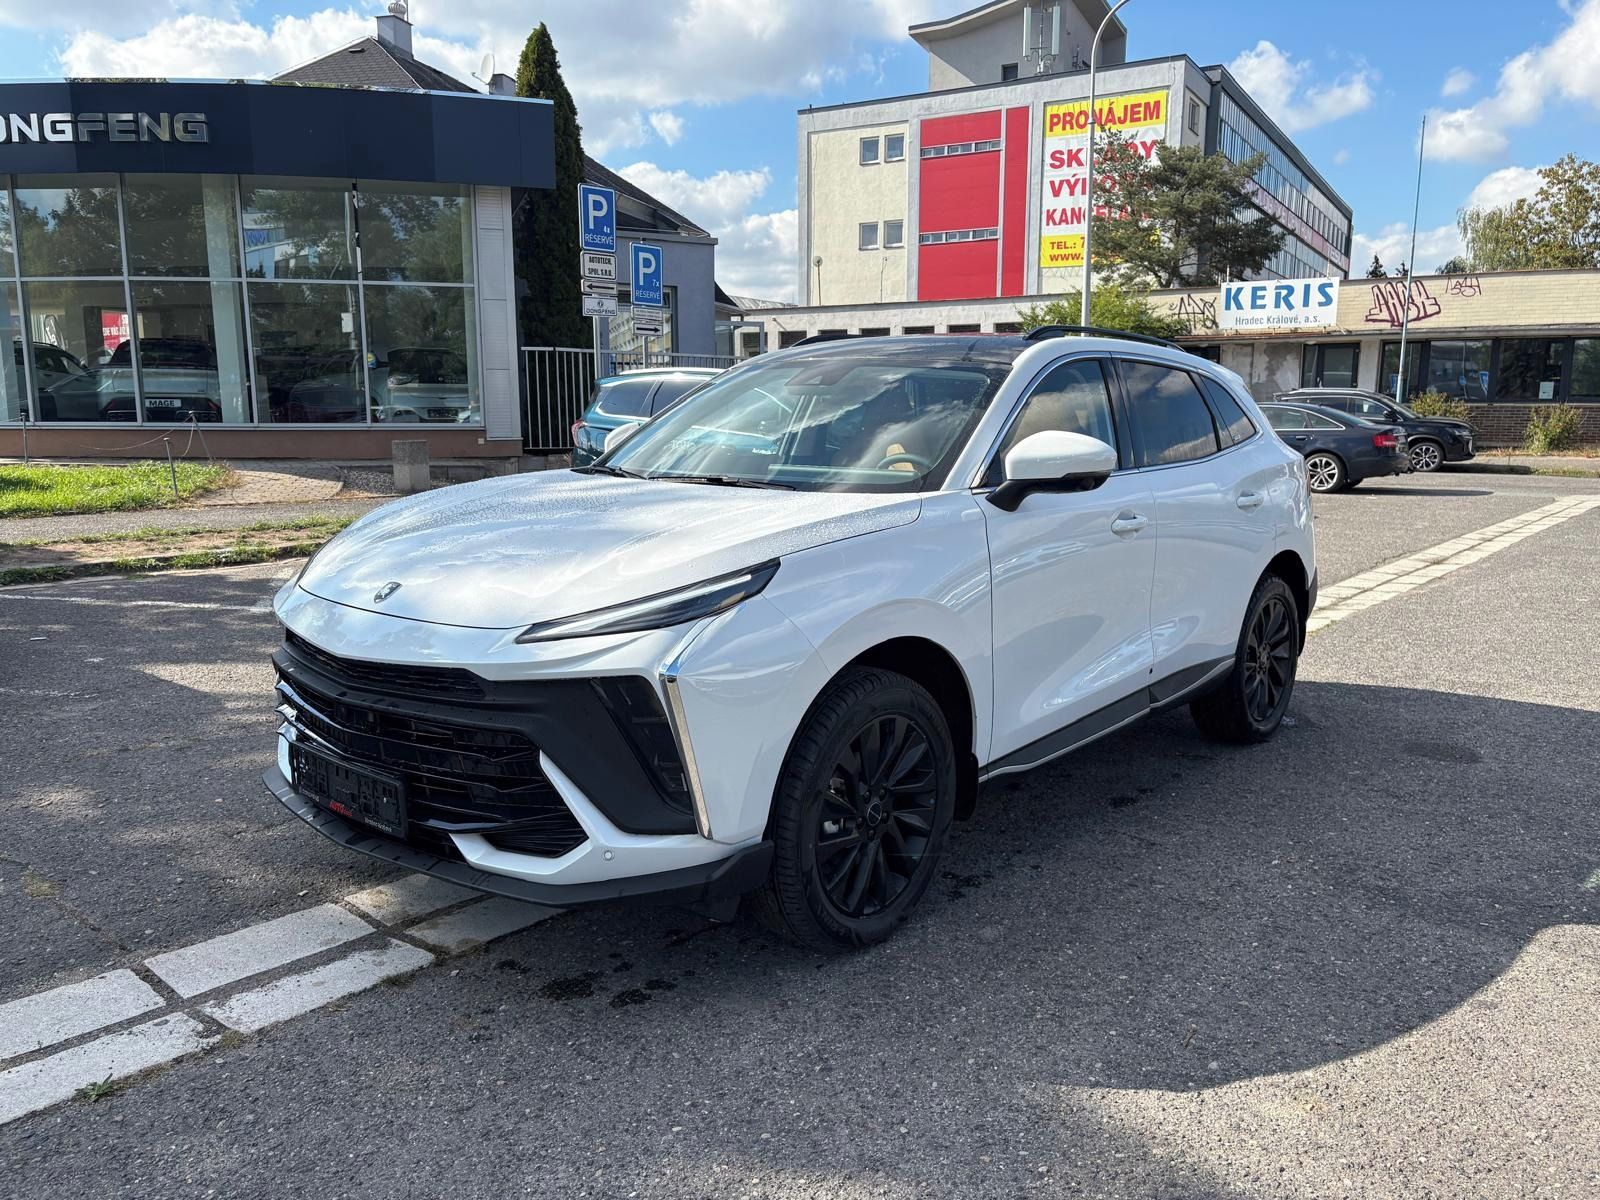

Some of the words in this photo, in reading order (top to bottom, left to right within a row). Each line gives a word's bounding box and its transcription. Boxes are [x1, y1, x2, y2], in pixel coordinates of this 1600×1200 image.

[0, 113, 209, 142] NGFENG
[1049, 100, 1161, 132] PRONÁJEM
[588, 193, 608, 229] P
[638, 251, 656, 286] P
[1224, 282, 1335, 312] KERIS
[1235, 316, 1264, 326] Hradec
[1266, 314, 1302, 325] Králové,
[1304, 314, 1321, 324] a.s.
